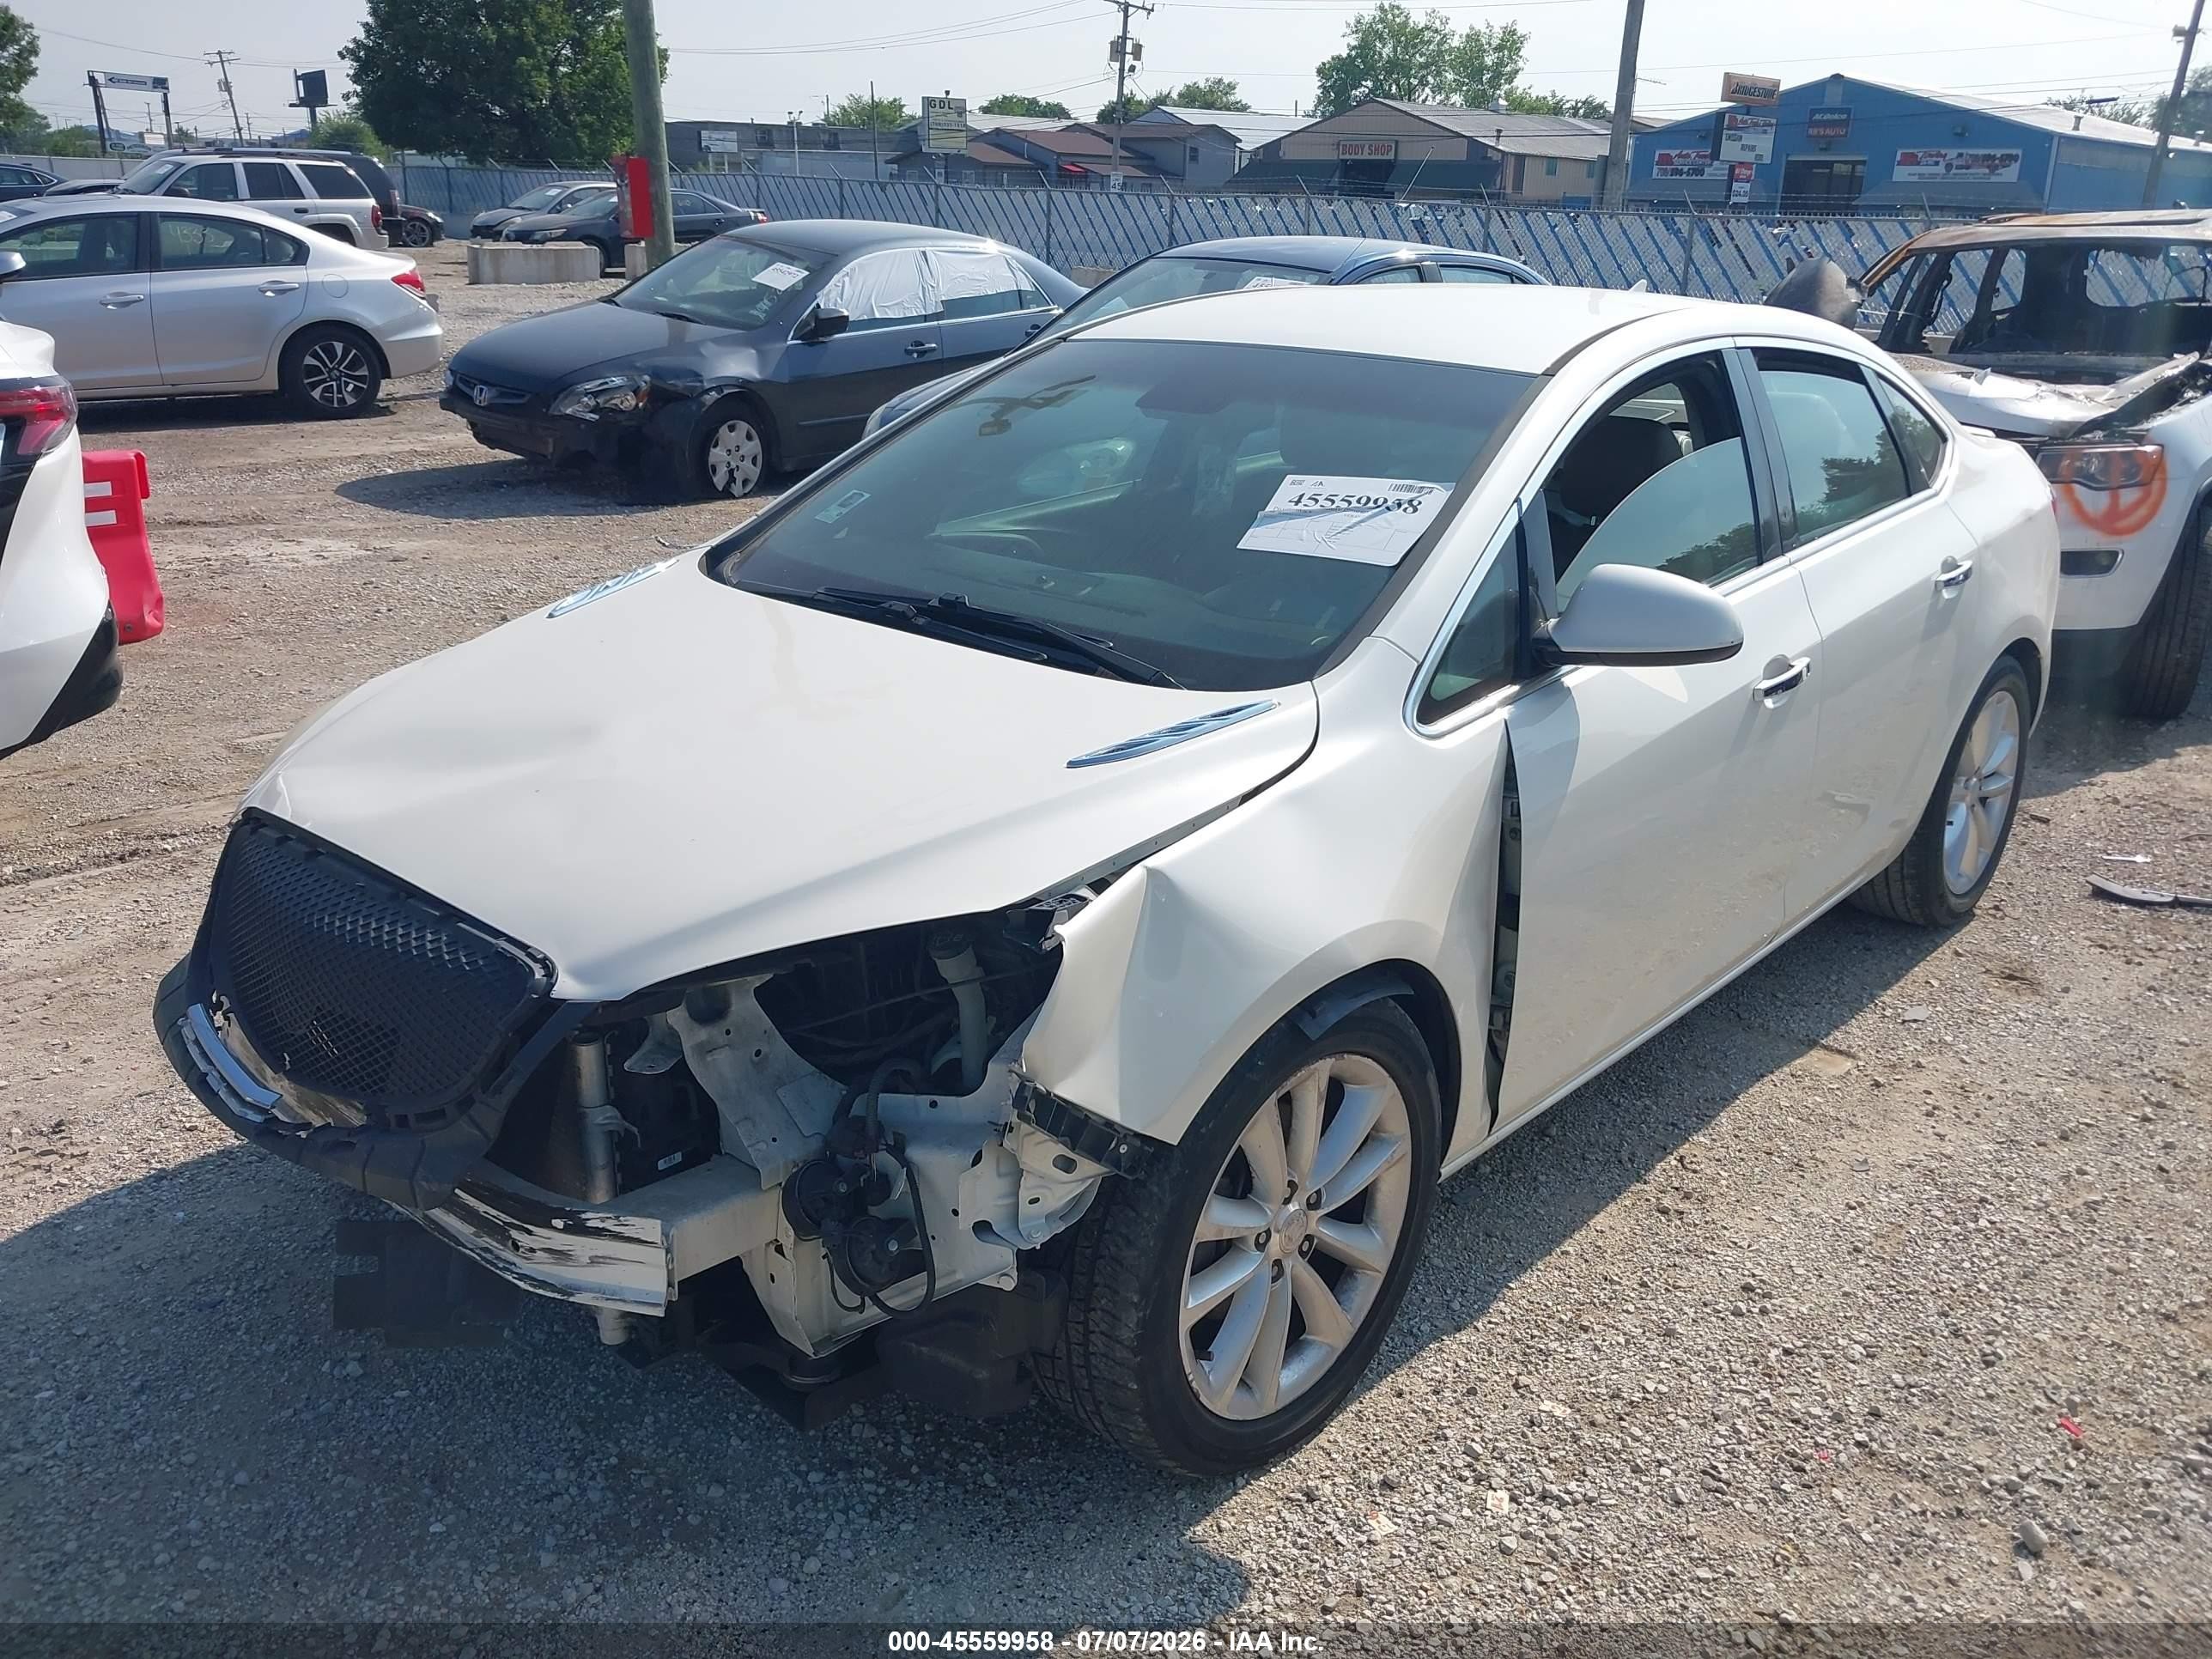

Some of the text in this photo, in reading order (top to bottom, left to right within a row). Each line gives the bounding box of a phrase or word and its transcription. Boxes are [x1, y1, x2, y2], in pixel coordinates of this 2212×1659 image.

[929, 99, 954, 110] GDL
[1341, 143, 1393, 155] BODY SHOP
